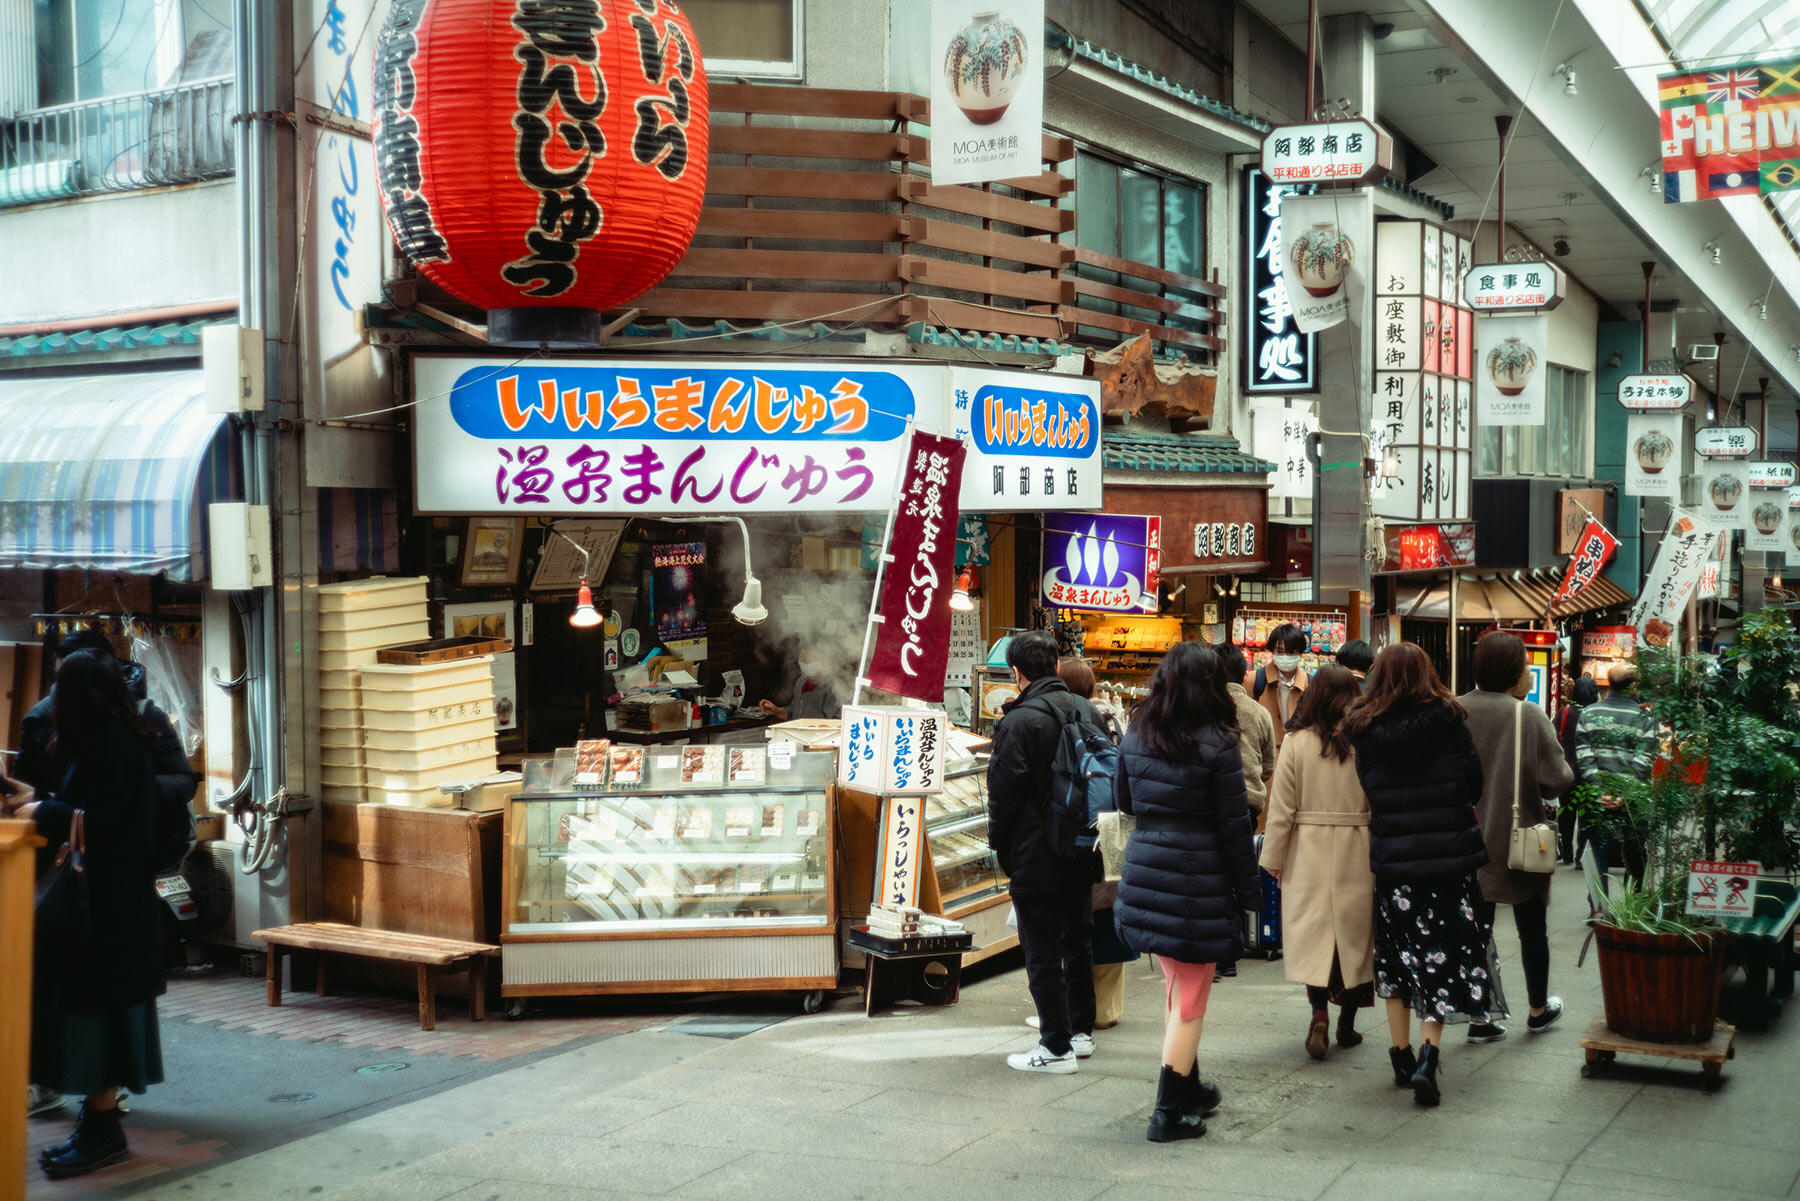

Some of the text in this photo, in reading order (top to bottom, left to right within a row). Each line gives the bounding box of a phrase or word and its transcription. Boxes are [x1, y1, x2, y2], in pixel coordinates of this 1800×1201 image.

[953, 136, 1018, 155] MOA美術館
[1274, 133, 1363, 158] 阿部商店
[1272, 162, 1363, 180] 平和通り名店街
[1479, 271, 1541, 291] 食事処
[1384, 273, 1407, 490] お座敷御利用下い
[497, 374, 869, 434] いいらまんじゅう
[497, 445, 876, 507] 温泉まんじゅう
[992, 465, 1078, 496] 阿部商店
[1196, 522, 1255, 557] 阿部商店
[1048, 582, 1131, 608] 温泉まんじゅう
[848, 722, 861, 782] まんじゅう
[863, 716, 877, 761] いいら
[893, 717, 914, 789] いいらまんじゅう
[918, 718, 938, 788] 温泉まんじゅう
